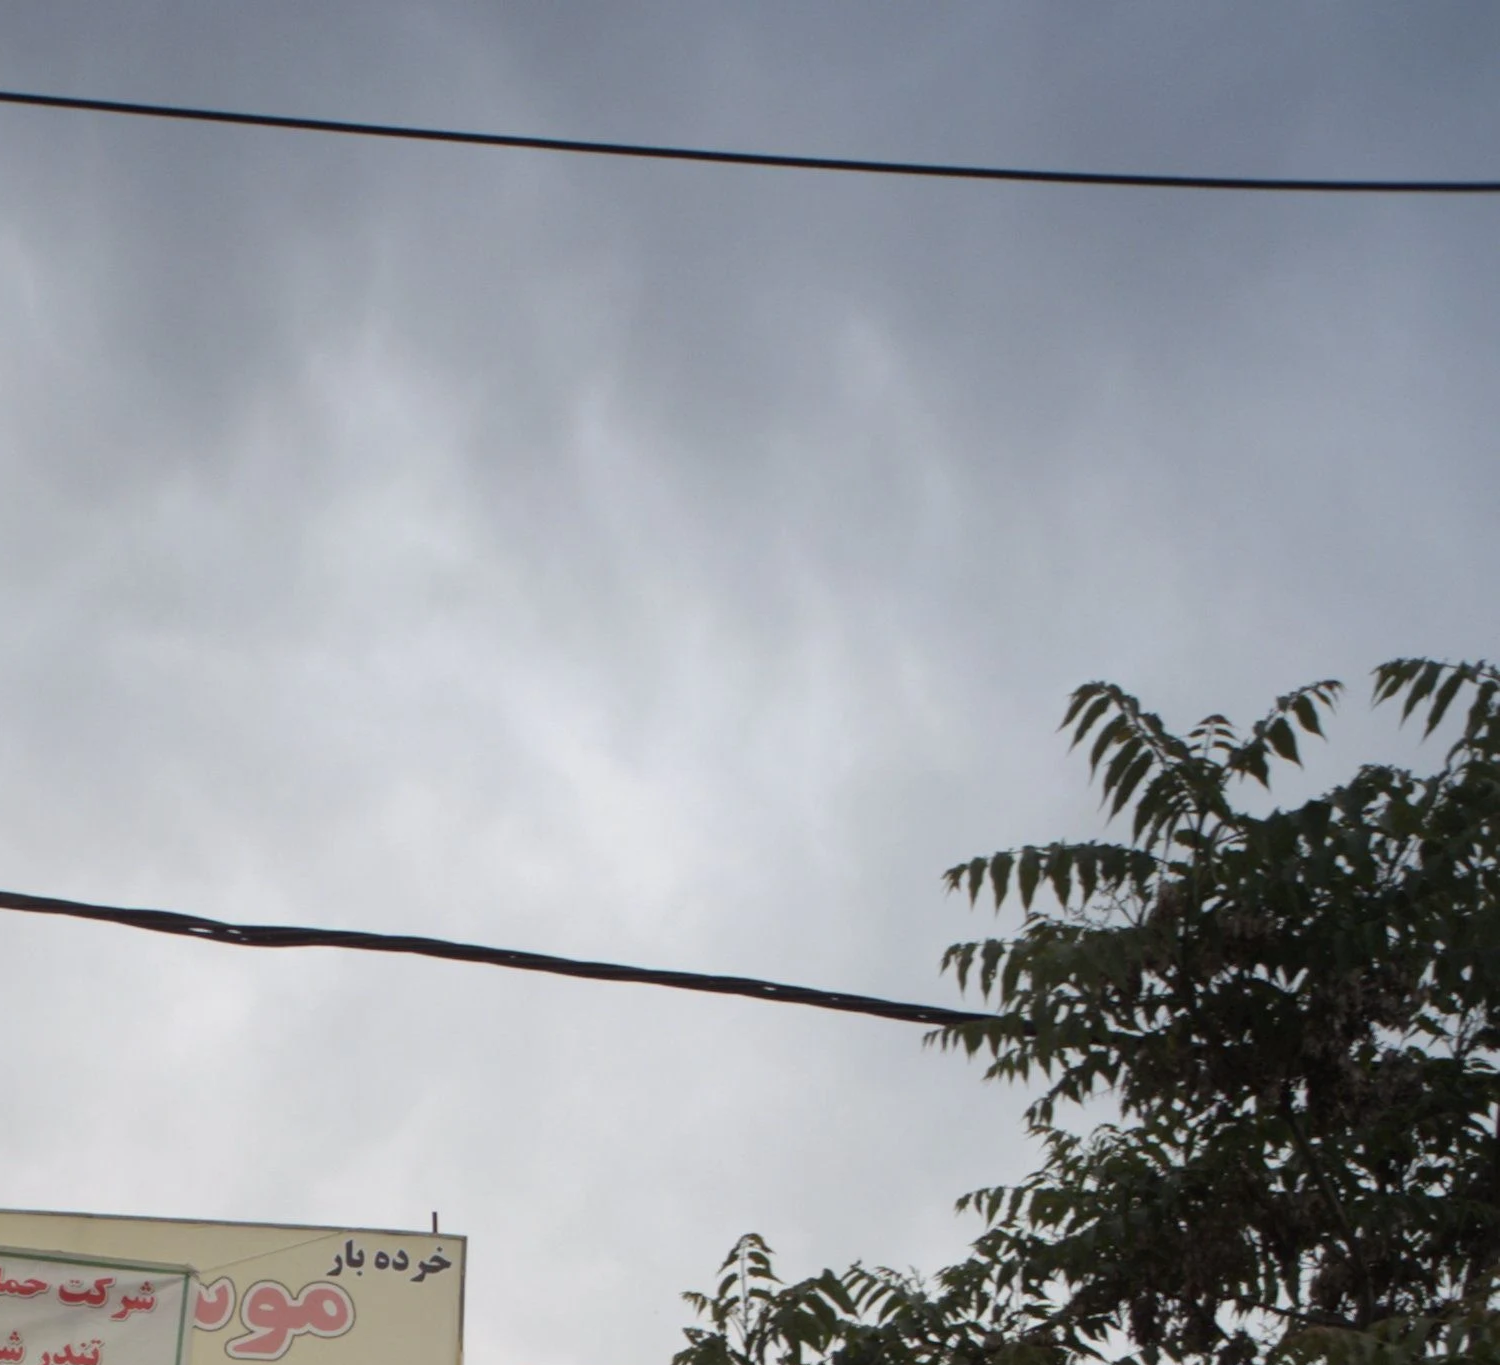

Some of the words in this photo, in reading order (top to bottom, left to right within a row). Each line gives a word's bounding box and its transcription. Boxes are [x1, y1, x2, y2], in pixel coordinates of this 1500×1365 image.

[326, 1239, 366, 1277] بار
[374, 1246, 452, 1282] خرده
[57, 1276, 158, 1321] شرکت
